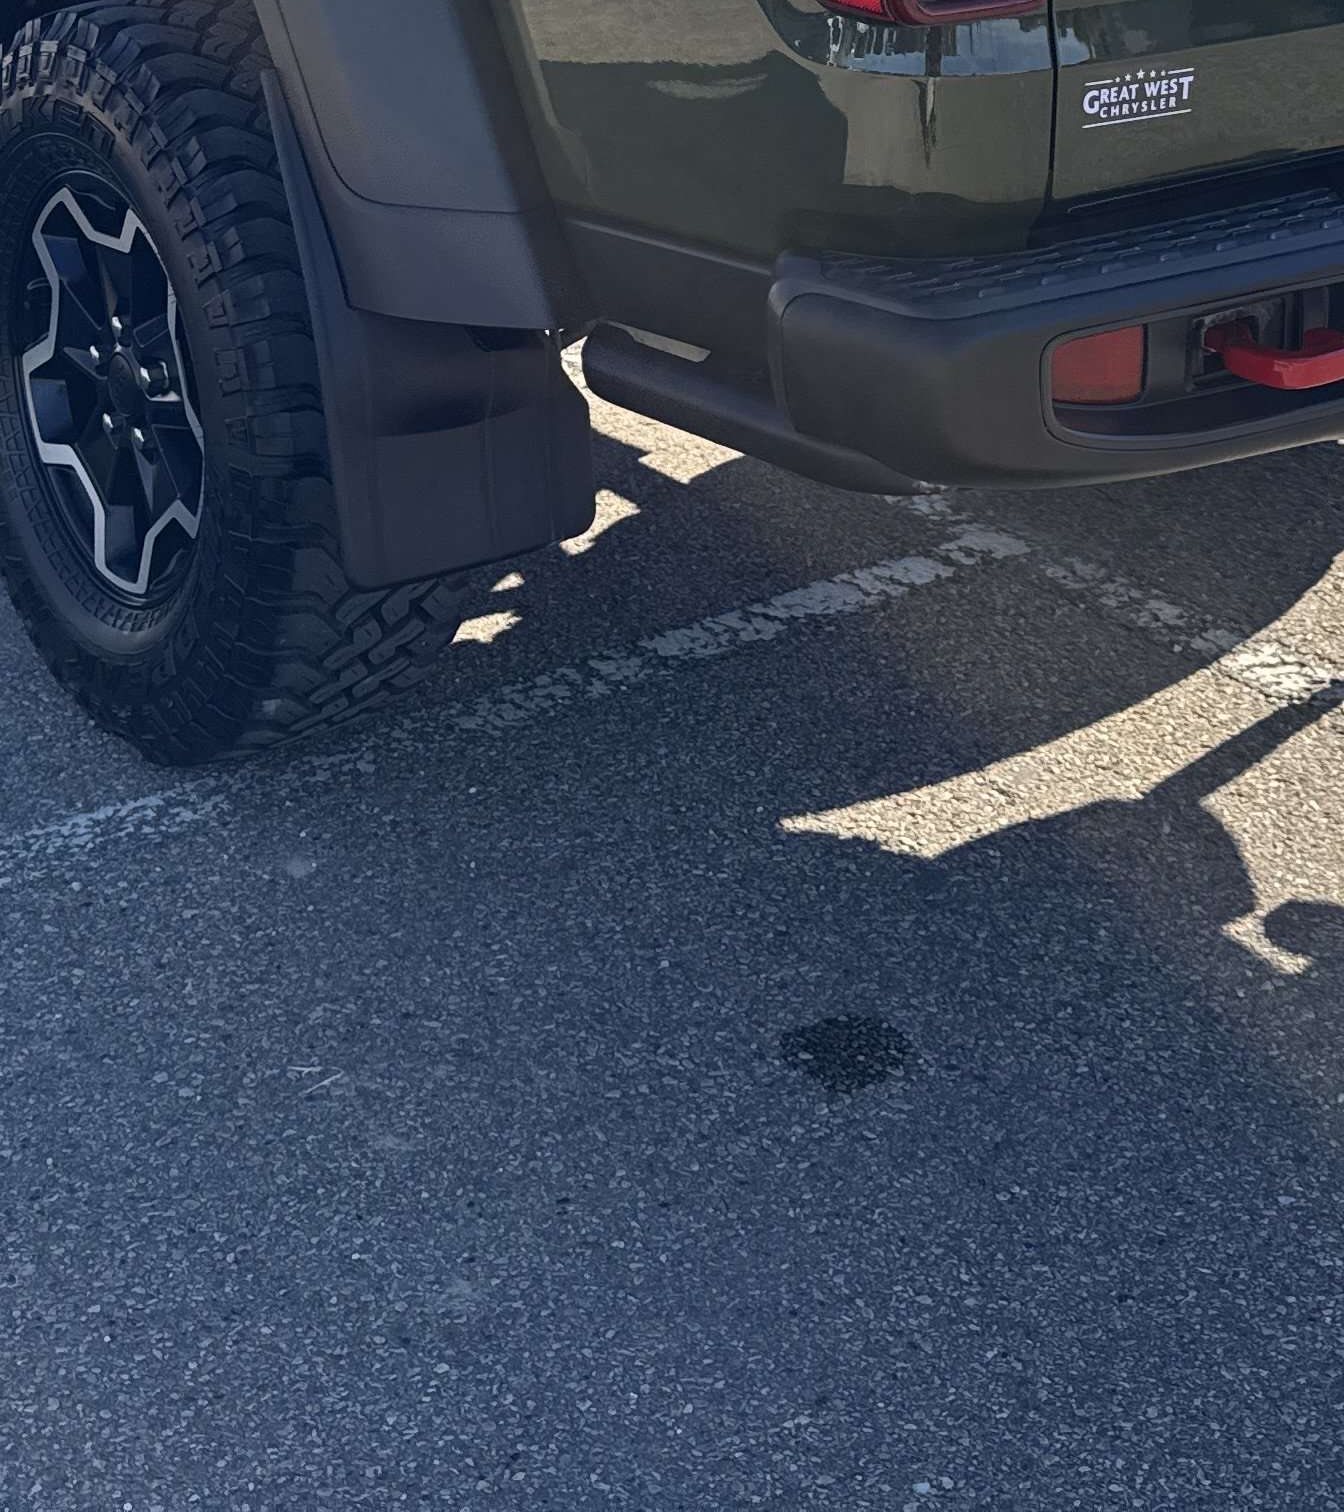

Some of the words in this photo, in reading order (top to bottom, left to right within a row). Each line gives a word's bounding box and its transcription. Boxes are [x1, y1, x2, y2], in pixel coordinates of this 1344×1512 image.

[1082, 83, 1139, 115] GREAT
[1144, 75, 1194, 100] WEST
[1099, 96, 1177, 118] CHRYSLER
